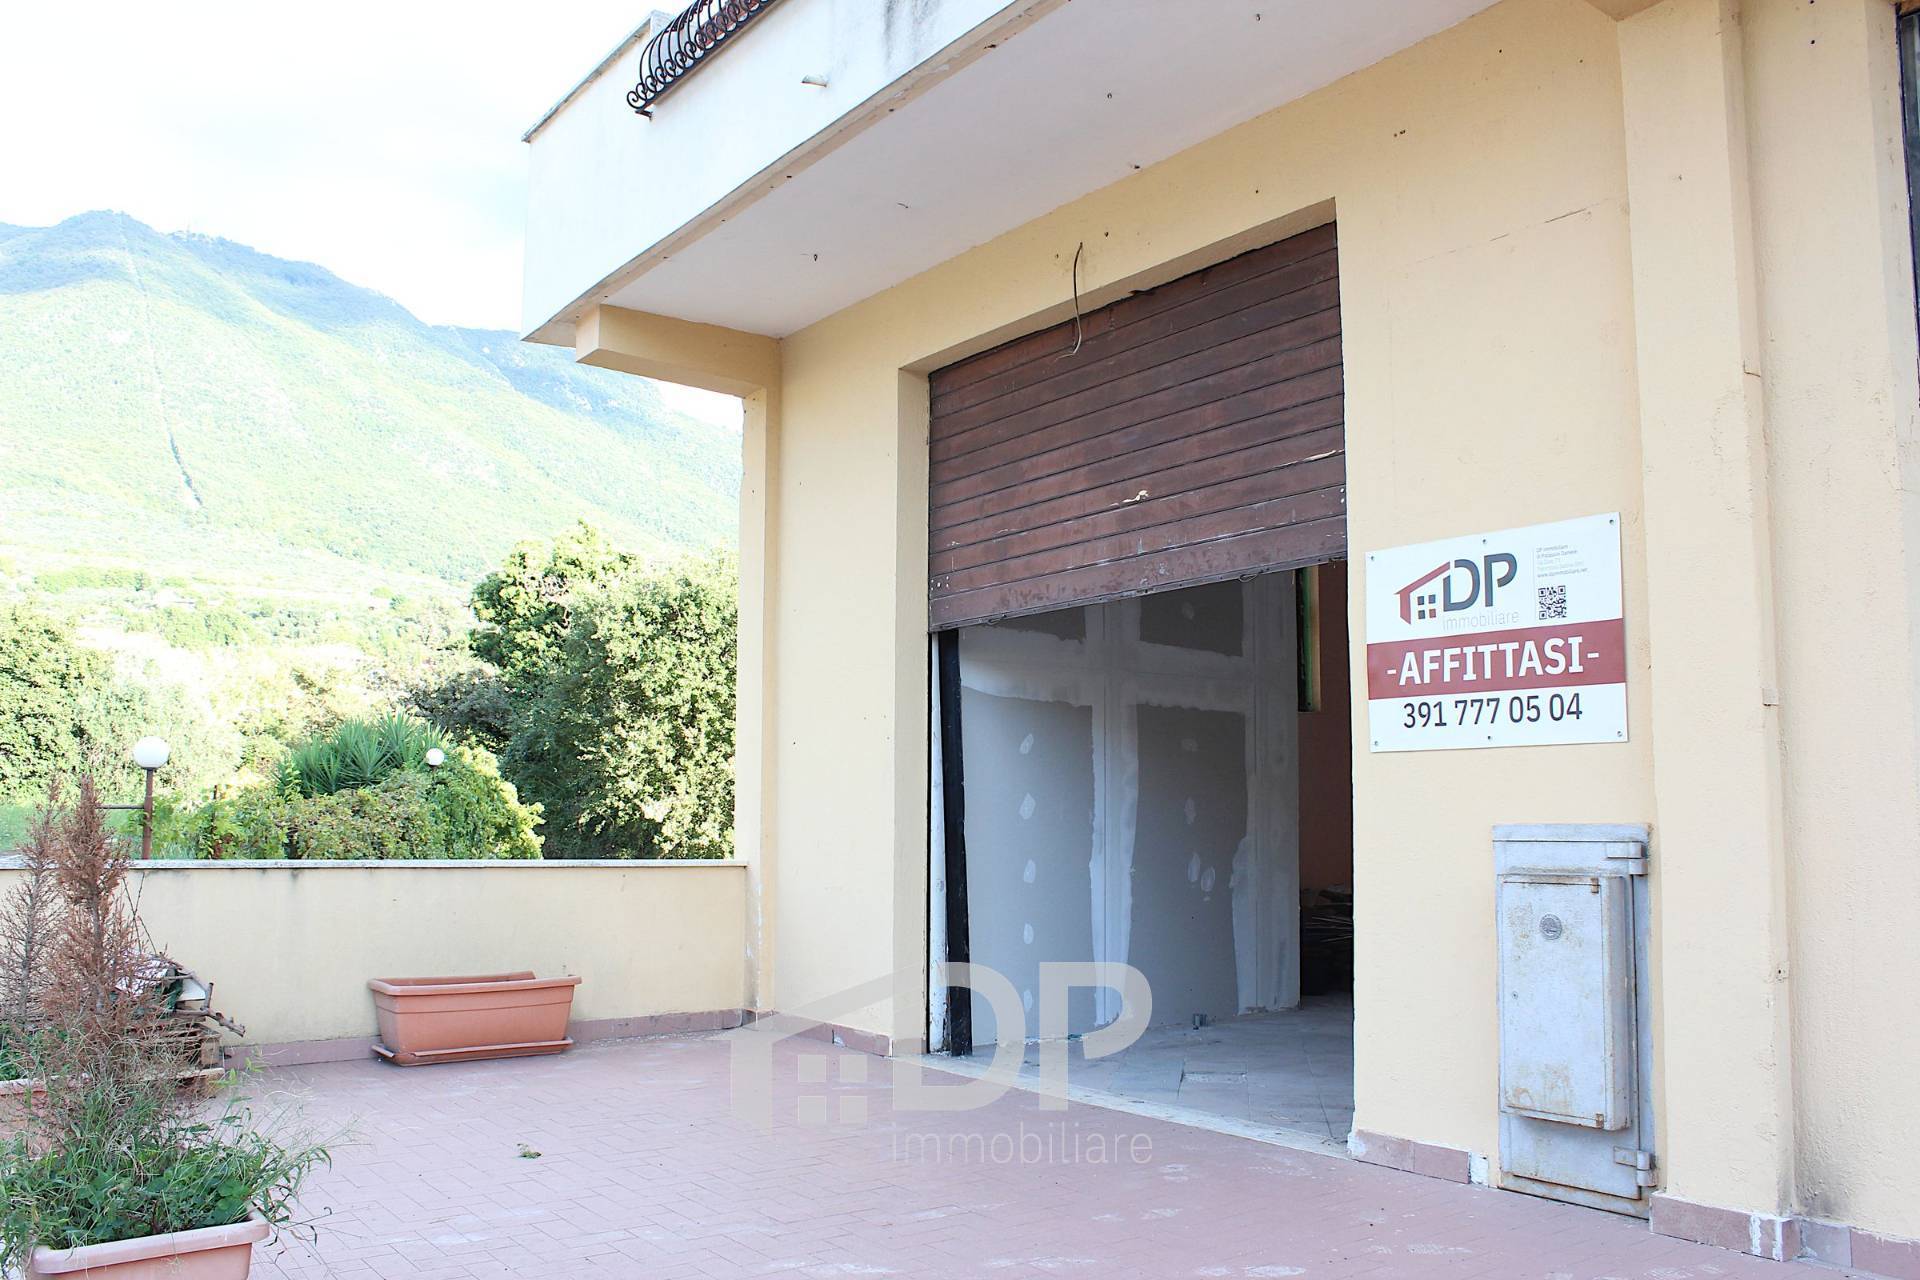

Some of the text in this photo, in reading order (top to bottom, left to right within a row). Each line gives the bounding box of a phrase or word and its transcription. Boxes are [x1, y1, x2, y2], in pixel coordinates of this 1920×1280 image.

[1443, 553, 1517, 612] DP
[1442, 609, 1520, 632] immobiliare
[1403, 692, 1583, 728] 391 777 05 04
